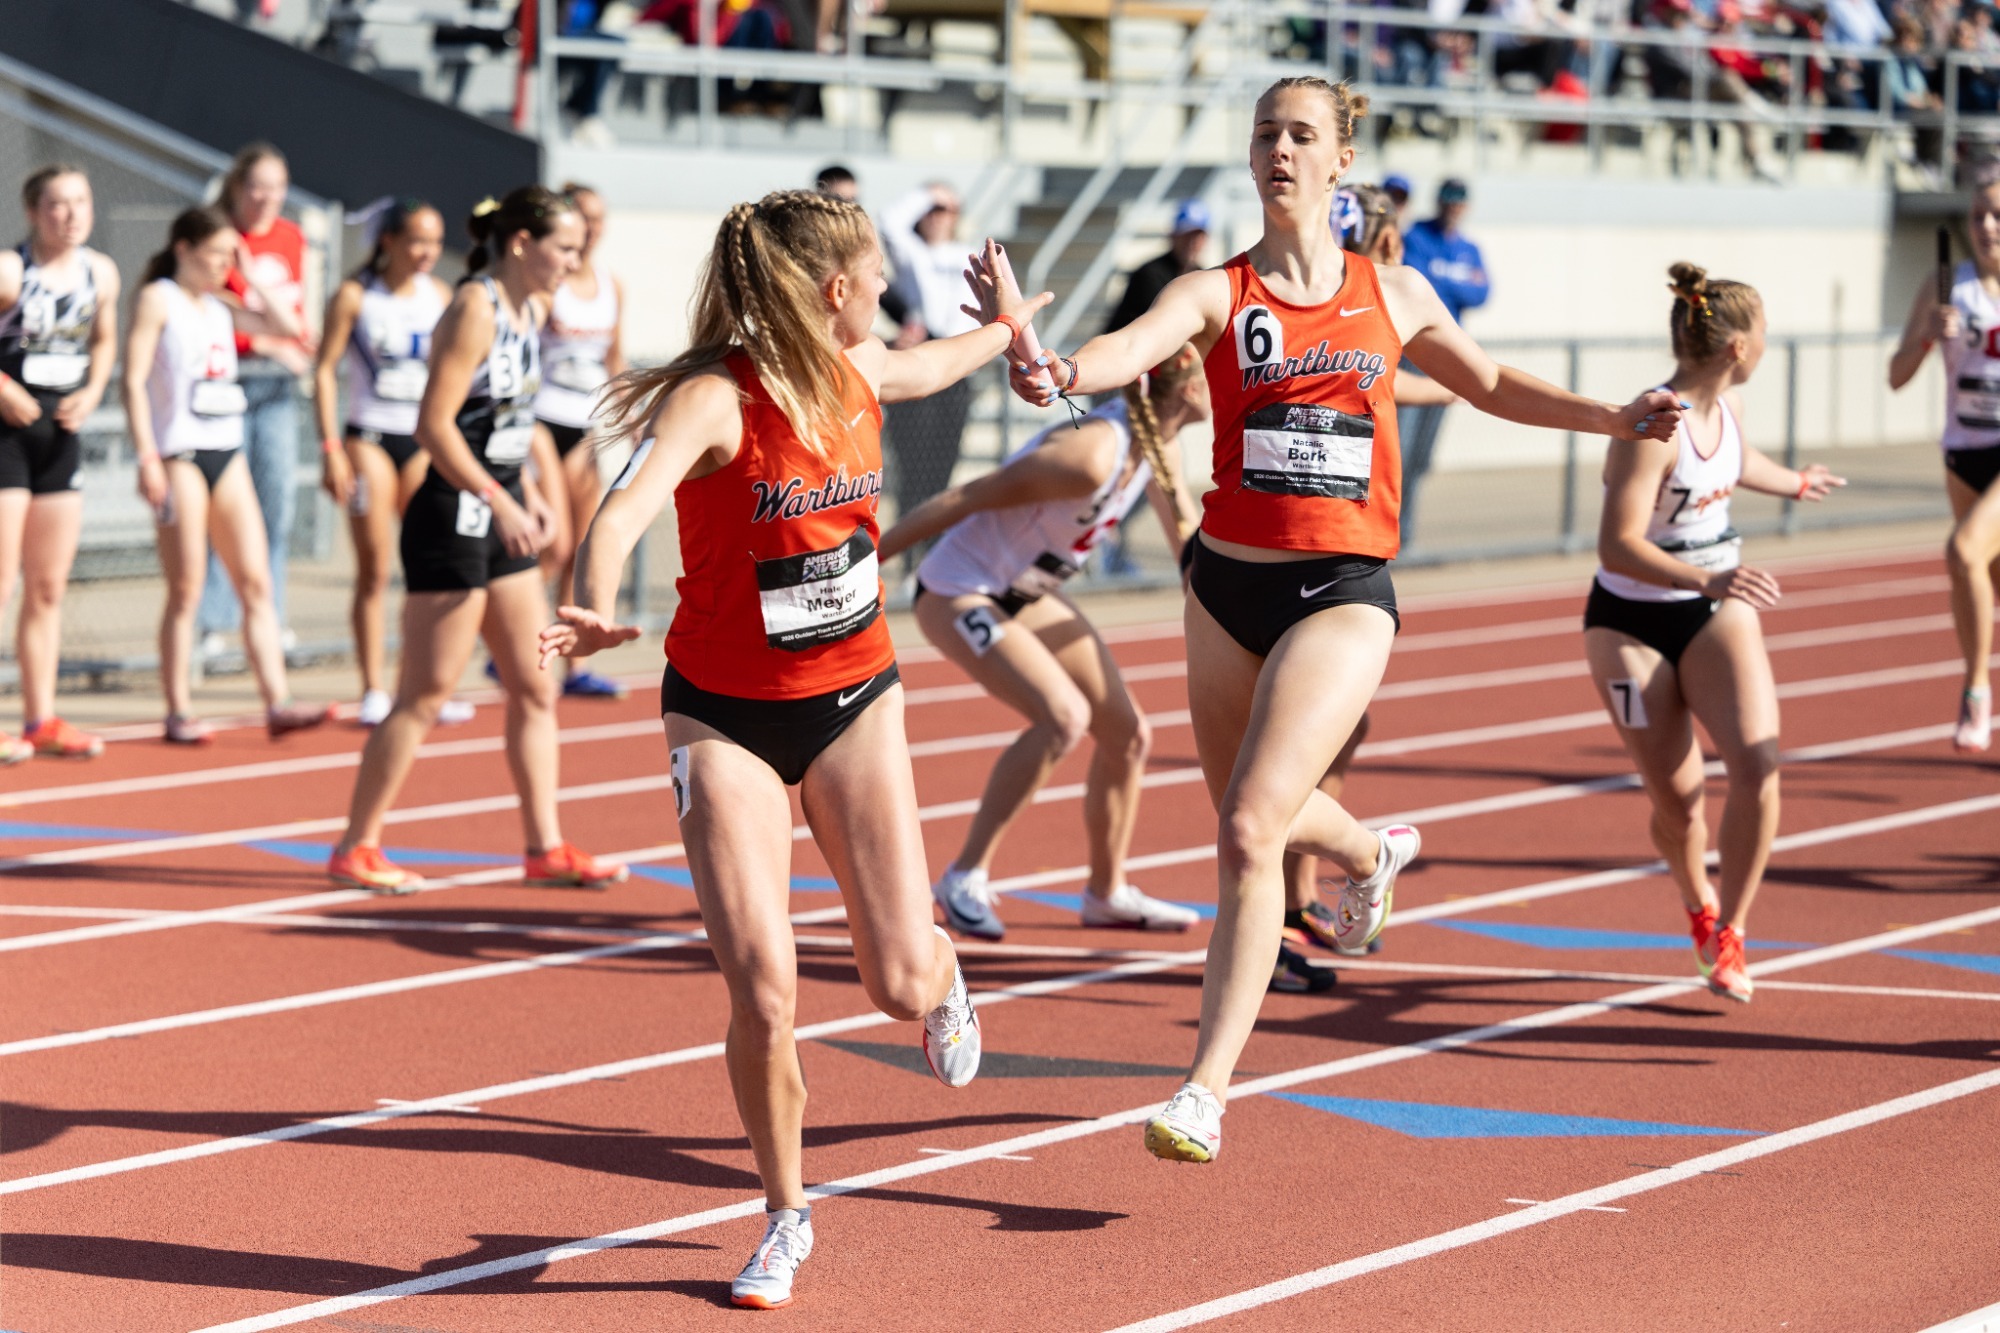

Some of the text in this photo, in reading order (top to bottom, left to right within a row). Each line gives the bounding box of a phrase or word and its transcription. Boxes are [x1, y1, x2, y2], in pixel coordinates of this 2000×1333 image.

[1244, 308, 1272, 363] 6
[1967, 314, 1982, 348] 5
[499, 354, 514, 392] 3
[1287, 407, 1338, 418] AMERICAN
[1288, 448, 1327, 462] Bork
[1293, 439, 1324, 448] Natalie
[1668, 487, 1691, 525] 7
[807, 588, 856, 612] Meyer
[964, 608, 991, 647] 5
[1611, 683, 1631, 724] 7
